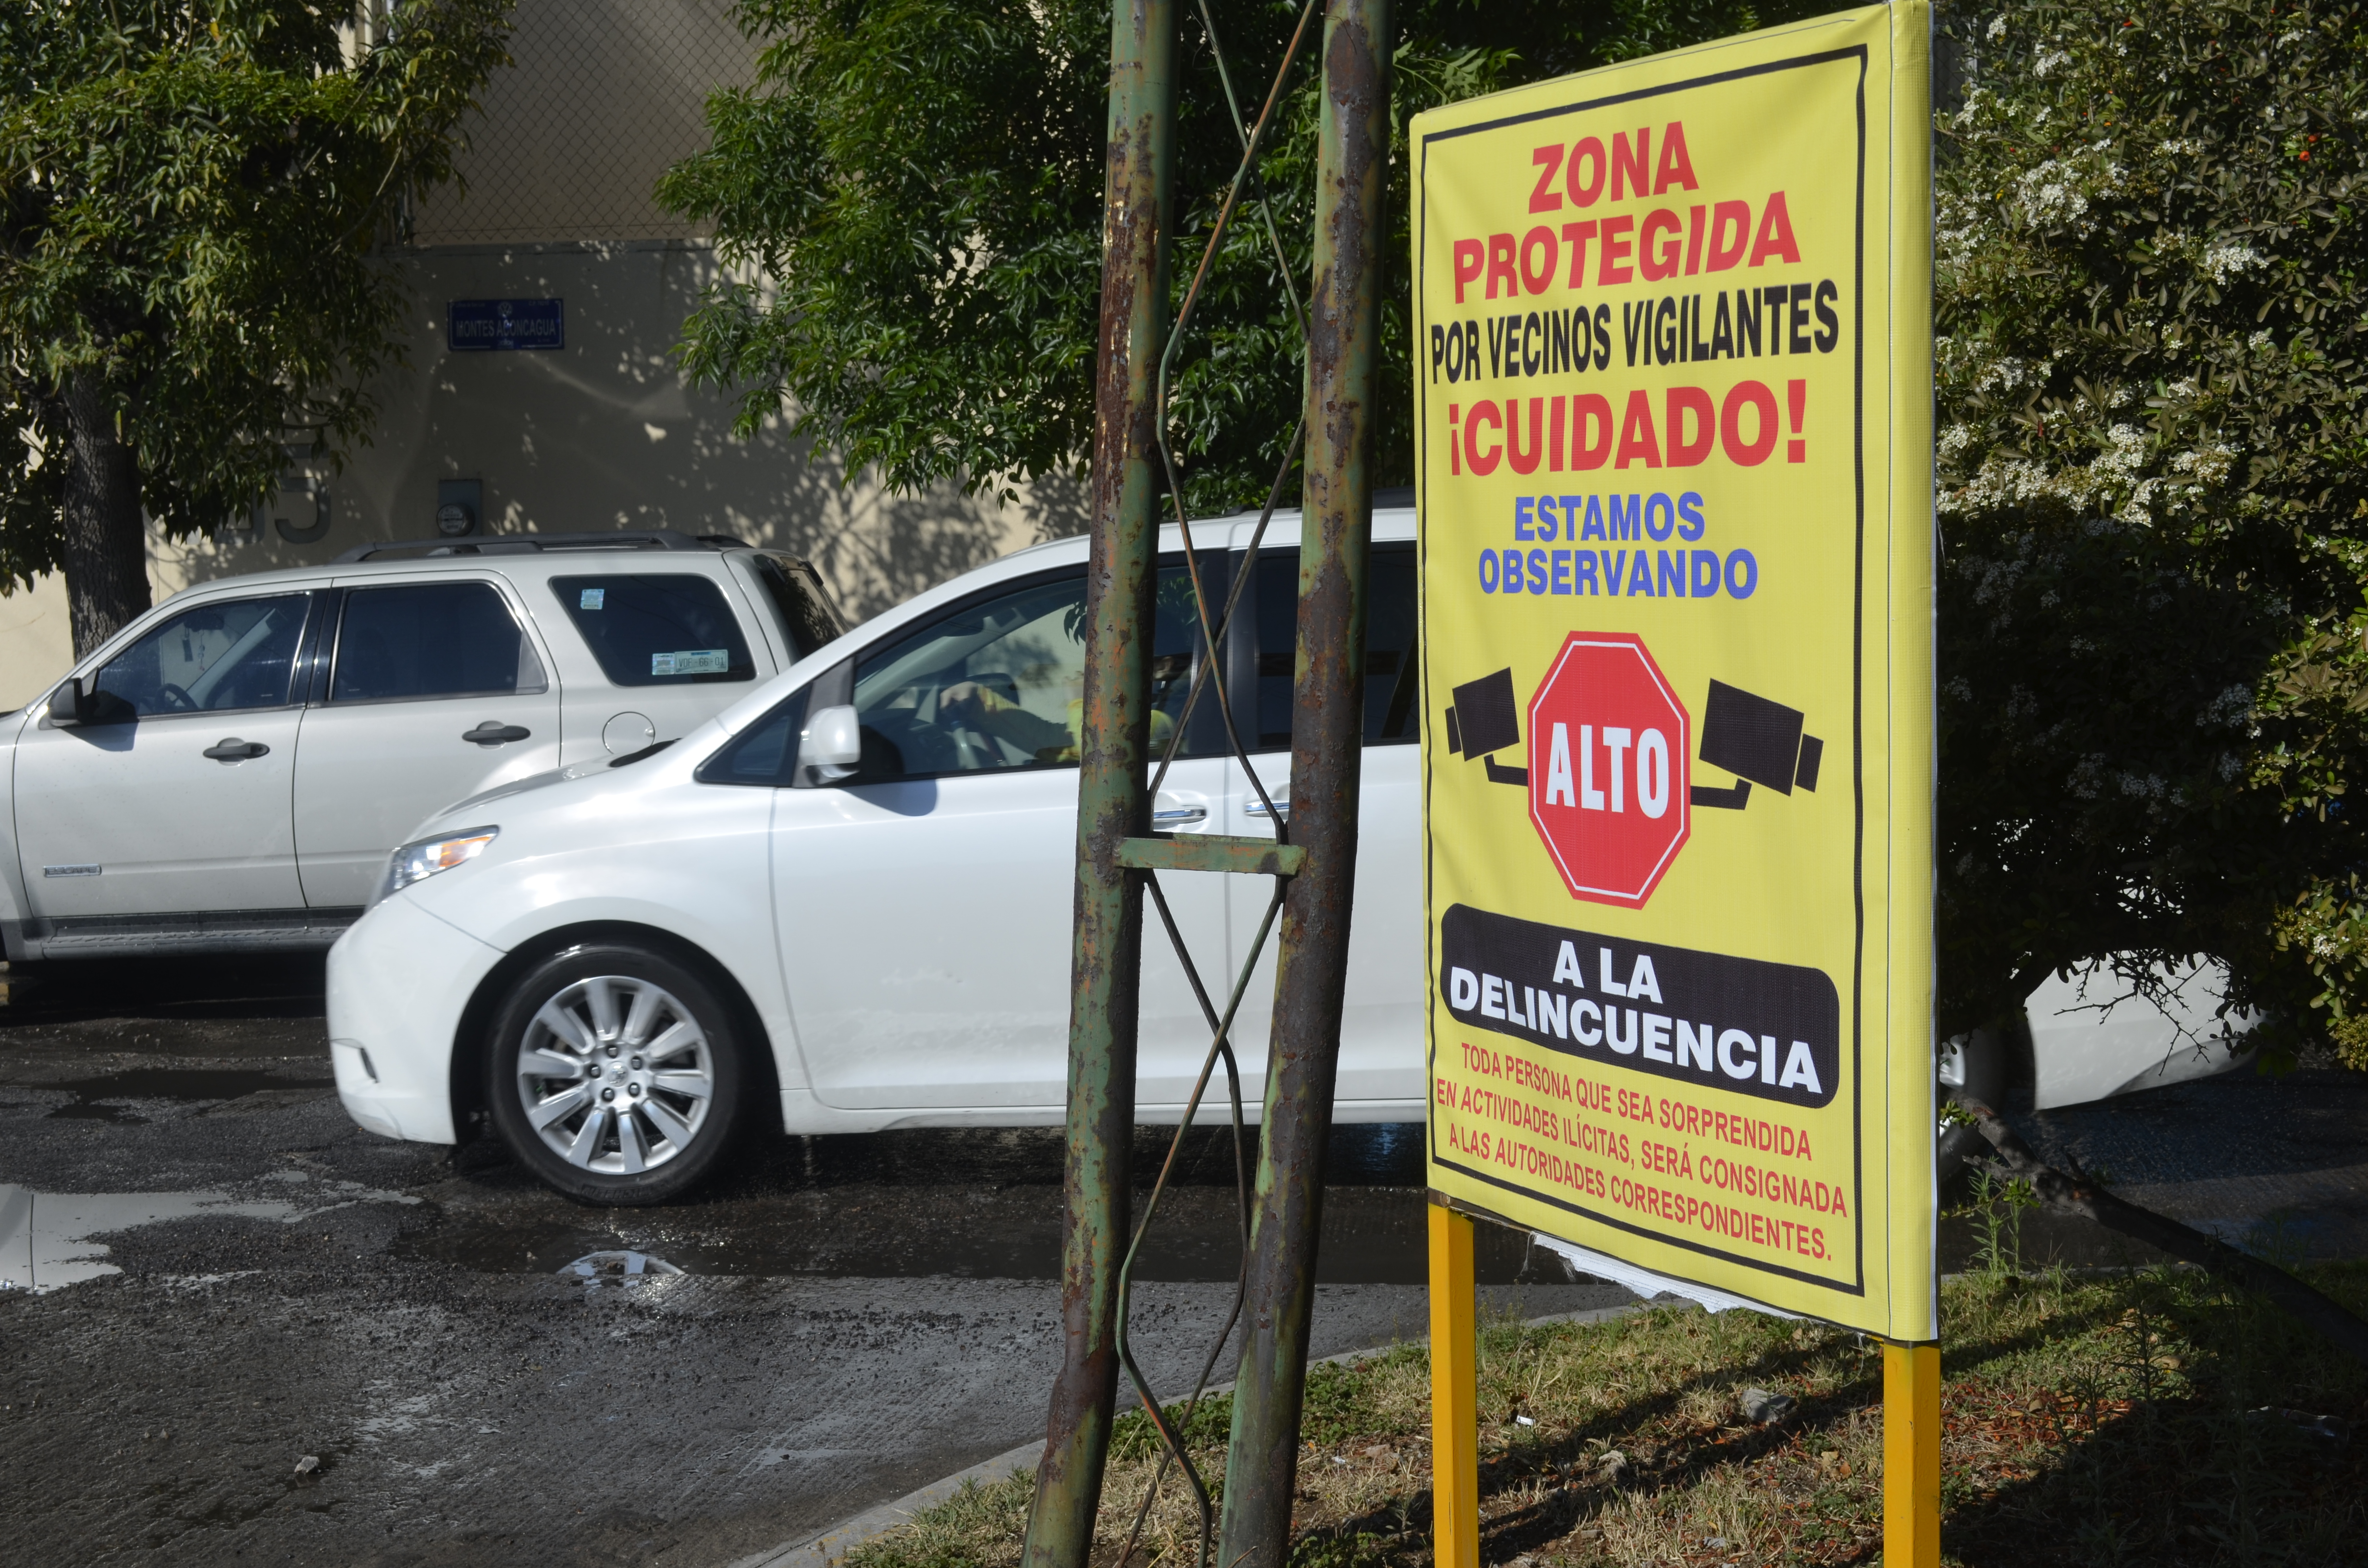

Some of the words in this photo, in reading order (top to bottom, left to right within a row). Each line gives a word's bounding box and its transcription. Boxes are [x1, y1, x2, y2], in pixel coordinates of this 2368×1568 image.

[1529, 121, 1700, 214] ZONA
[1454, 191, 1801, 304] PROTEGIDA
[456, 319, 494, 338] MONTES
[496, 318, 556, 337] ACONCAGUA
[1431, 320, 1481, 384] POR
[1487, 303, 1611, 379] VECINOS
[1624, 279, 1839, 368] VIGILANTES
[1449, 379, 1806, 477] ¡CUIDADO!
[1516, 492, 1705, 541] ESTAMOS
[1480, 549, 1758, 599] OBSERVANDO
[1546, 722, 1669, 819] ALTO
[47, 867, 97, 875] ESCAPE
[1553, 940, 1584, 988] A
[1600, 947, 1663, 1004] LA
[1450, 966, 1822, 1094] DELINCUENCIA
[1437, 1078, 1457, 1108] EN
[1460, 1086, 1559, 1141] ACTIVIDADES
[1563, 1114, 1635, 1171] ILÍCITAS,
[1641, 1140, 1694, 1180] SERÁ
[1700, 1155, 1848, 1218] CONSIGNADA
[1461, 1042, 1503, 1079] TODA
[1505, 1054, 1573, 1102] PERSONA
[1577, 1078, 1612, 1114] QUE
[1618, 1088, 1654, 1125] SEA
[1659, 1098, 1813, 1161] SORPRENDIDA
[1450, 1123, 1459, 1149] A
[1461, 1127, 1491, 1160] LAS
[1494, 1137, 1606, 1199] AUTORIDADES
[1611, 1175, 1833, 1262] CORRESPONDIENTES.
